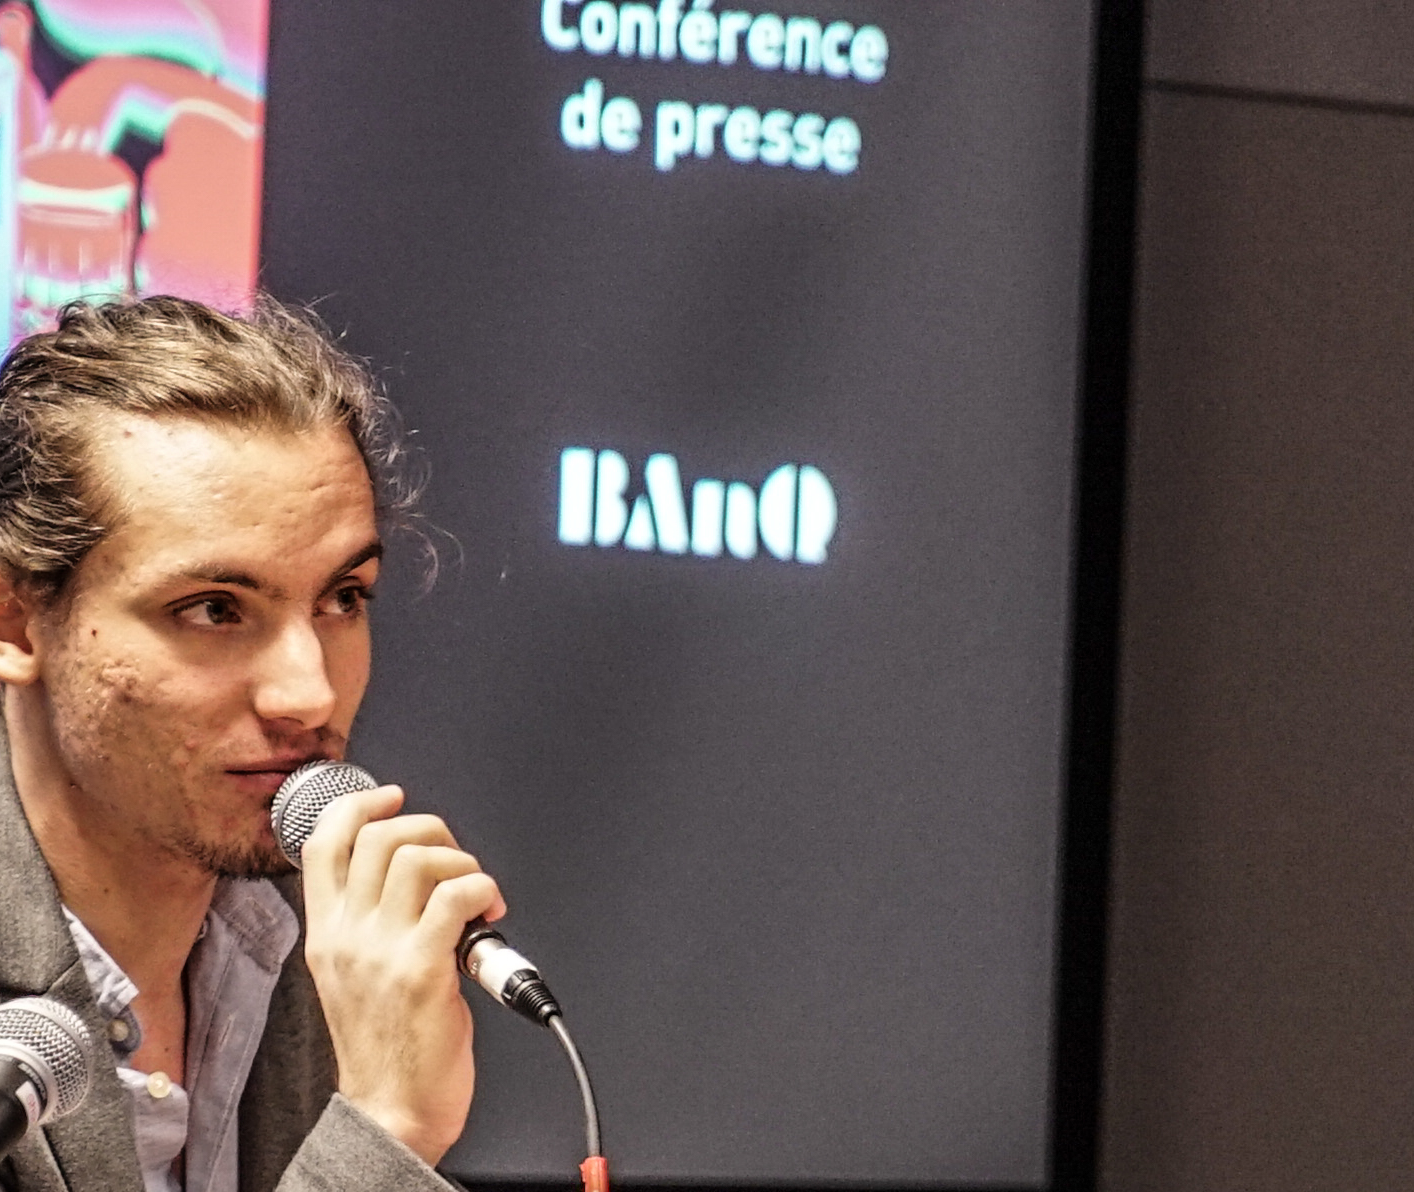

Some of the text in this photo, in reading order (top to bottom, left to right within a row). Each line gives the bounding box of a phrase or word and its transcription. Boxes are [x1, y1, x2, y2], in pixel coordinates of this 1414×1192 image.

[540, 0, 889, 84] Conférence
[560, 77, 863, 174] de presse
